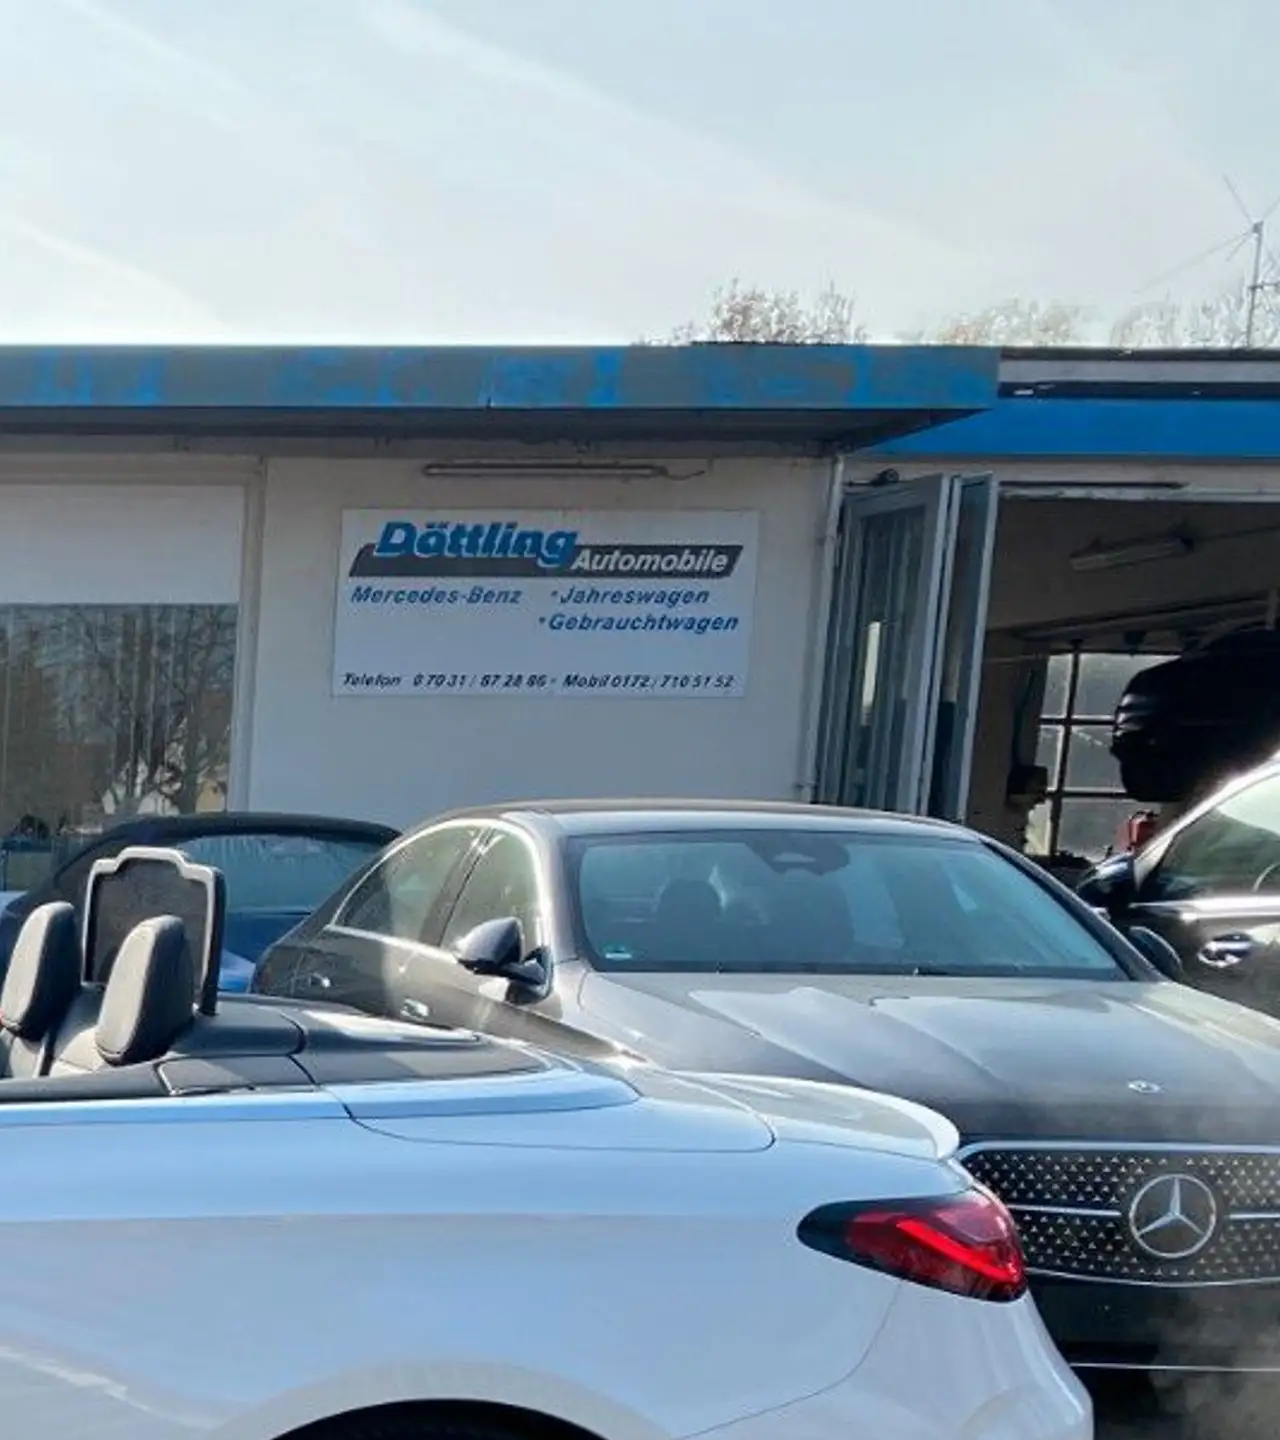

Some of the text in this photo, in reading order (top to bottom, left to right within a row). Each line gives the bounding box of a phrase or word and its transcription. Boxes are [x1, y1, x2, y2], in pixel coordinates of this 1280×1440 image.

[374, 520, 729, 573] Döttling Automobile
[351, 586, 710, 608] Mercedes-Benz Jahreswagen
[548, 613, 740, 635] Gebrauchtwagen
[342, 673, 402, 688] Telefon
